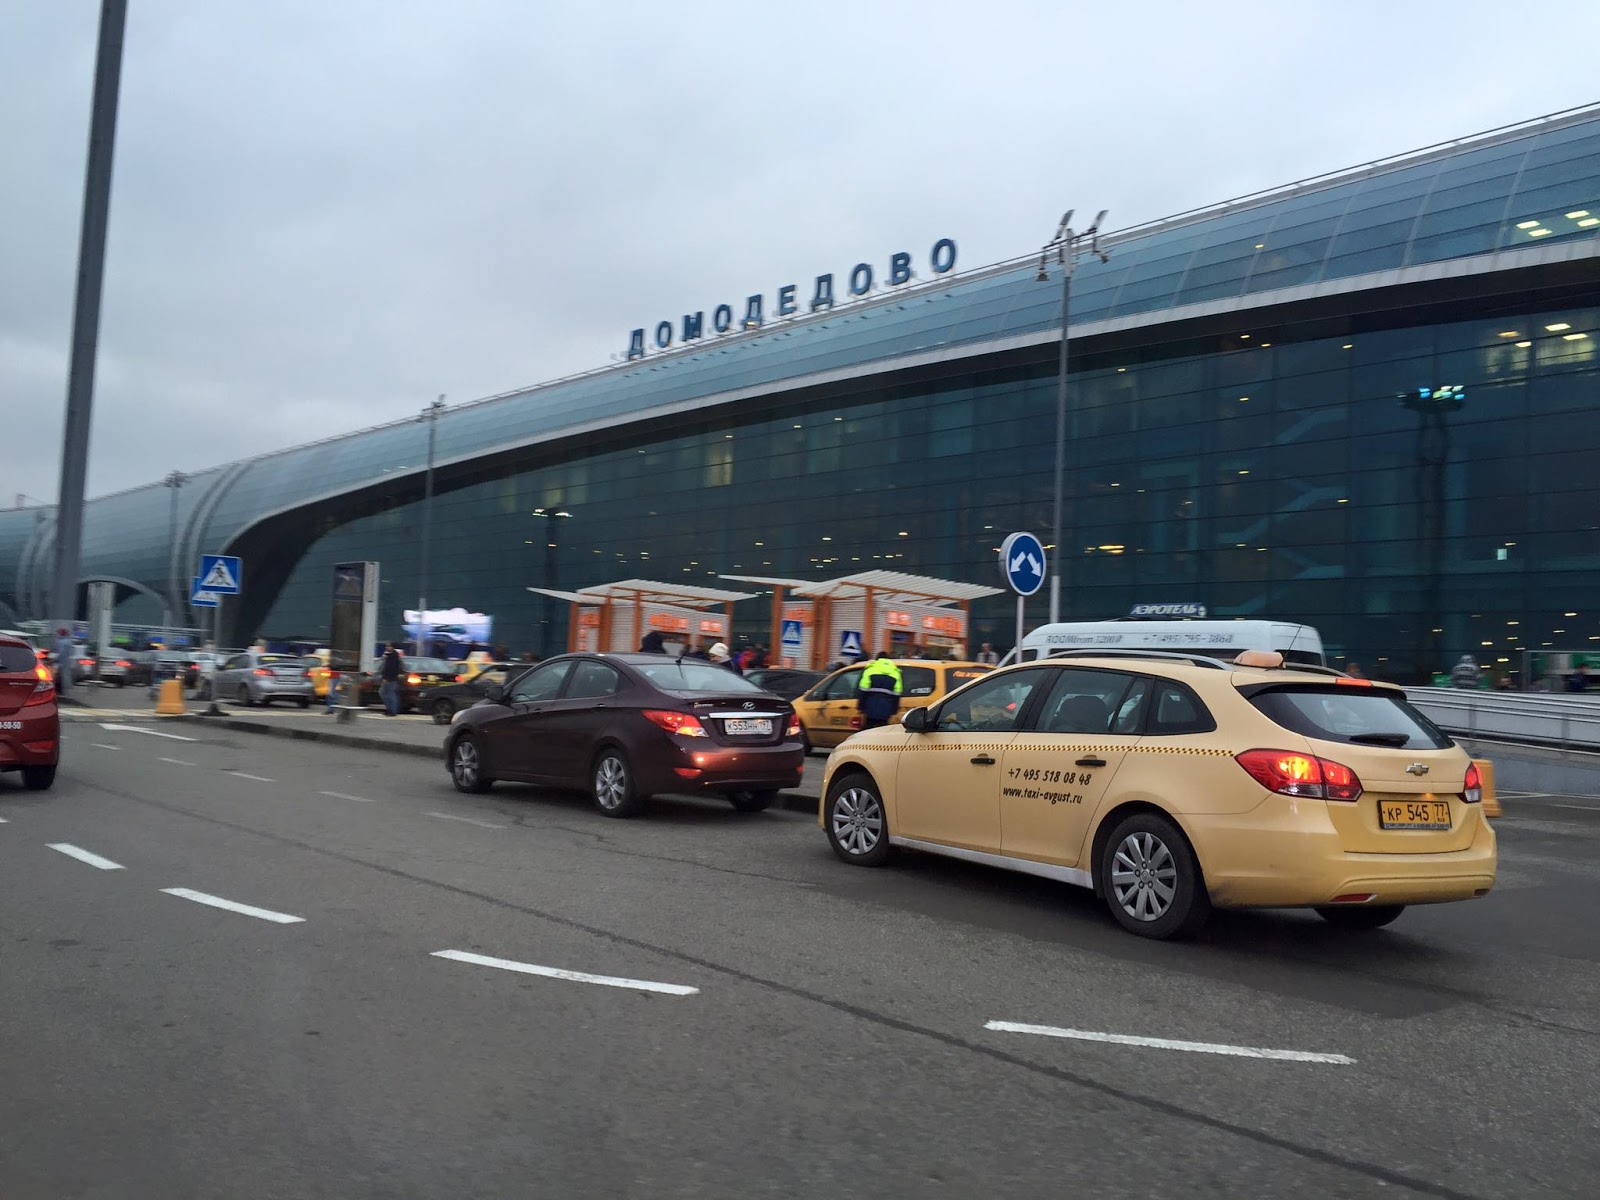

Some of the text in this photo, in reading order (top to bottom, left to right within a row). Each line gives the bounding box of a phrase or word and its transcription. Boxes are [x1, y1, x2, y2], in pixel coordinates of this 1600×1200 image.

[628, 237, 957, 362] ДОМОДЕДОВО
[1130, 604, 1198, 615] АЭРОТЕЛЬ
[1008, 768, 1092, 786] +7 495 518 08 48
[1003, 787, 1083, 805] www.taxi-avgust.ru
[1407, 804, 1430, 821] 545
[1434, 804, 1445, 817] 77
